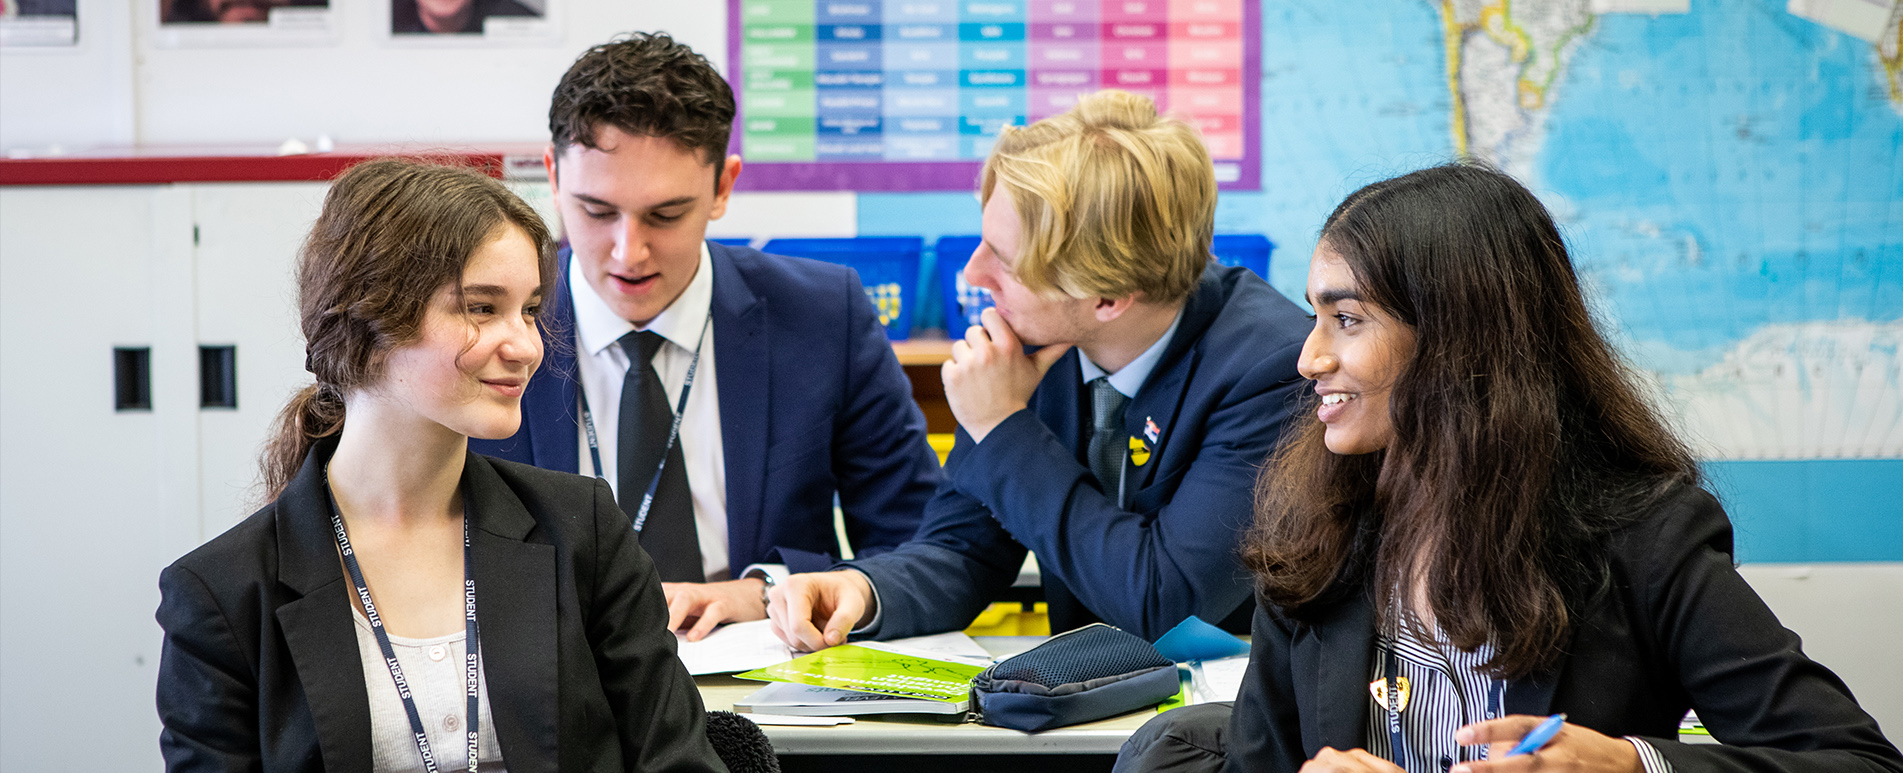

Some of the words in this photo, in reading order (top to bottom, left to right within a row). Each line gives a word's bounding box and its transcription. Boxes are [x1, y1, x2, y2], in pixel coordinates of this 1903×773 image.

[583, 411, 598, 449] STUDENT
[633, 493, 654, 532] STUDENT
[331, 514, 352, 556] STUDENT
[357, 586, 382, 628] STUDENT
[466, 579, 476, 621] STUDENT
[387, 657, 411, 700] STUDENT
[467, 653, 478, 698] STUDENT
[887, 674, 970, 688] hought
[1389, 687, 1400, 734] STUDENT
[468, 731, 478, 773] STUDEN
